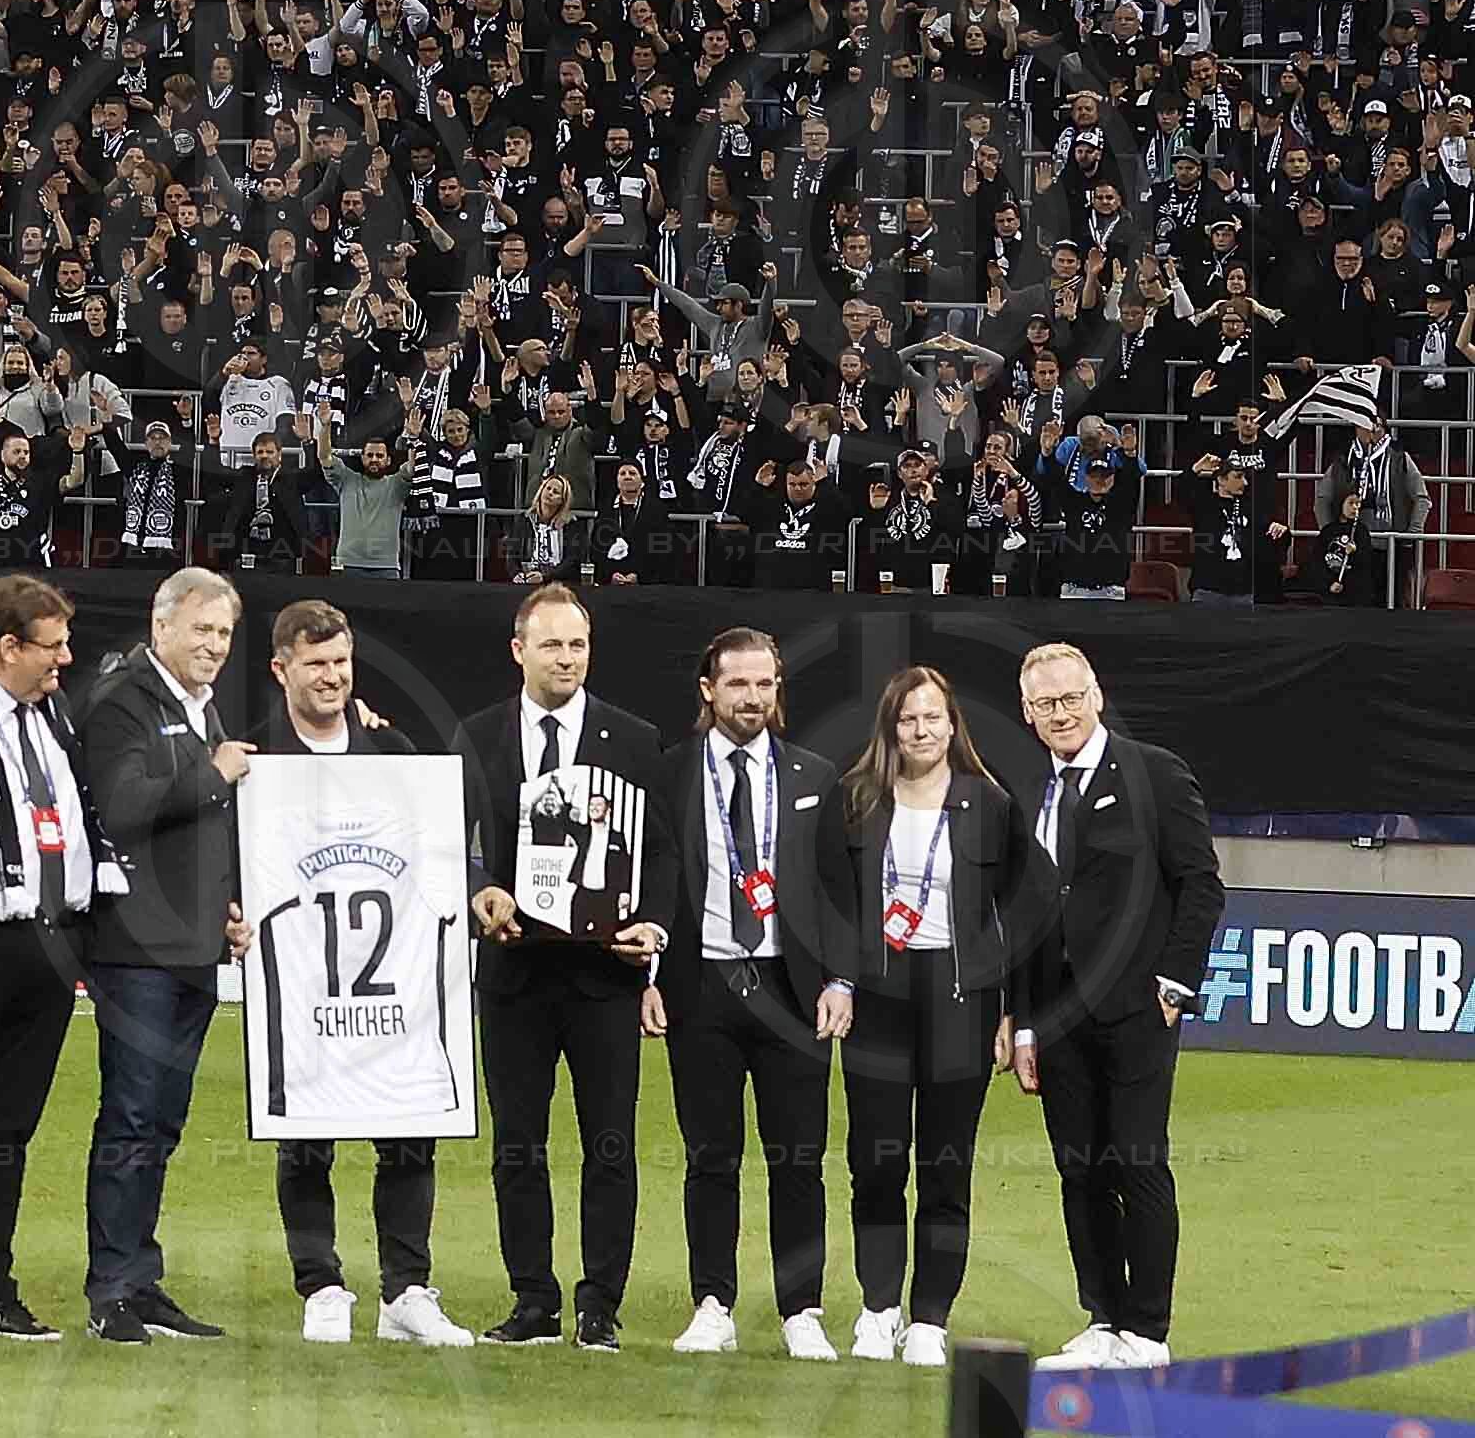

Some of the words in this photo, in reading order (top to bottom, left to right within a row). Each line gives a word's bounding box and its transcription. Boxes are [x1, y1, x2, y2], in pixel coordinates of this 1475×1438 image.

[49, 310, 83, 323] STURM
[300, 843, 407, 880] PUNTIGAMER
[532, 874, 562, 888] ANDI
[314, 889, 396, 998] 12
[1199, 928, 1475, 1033] #FOOTB
[313, 1003, 408, 1038] SCHICKER
